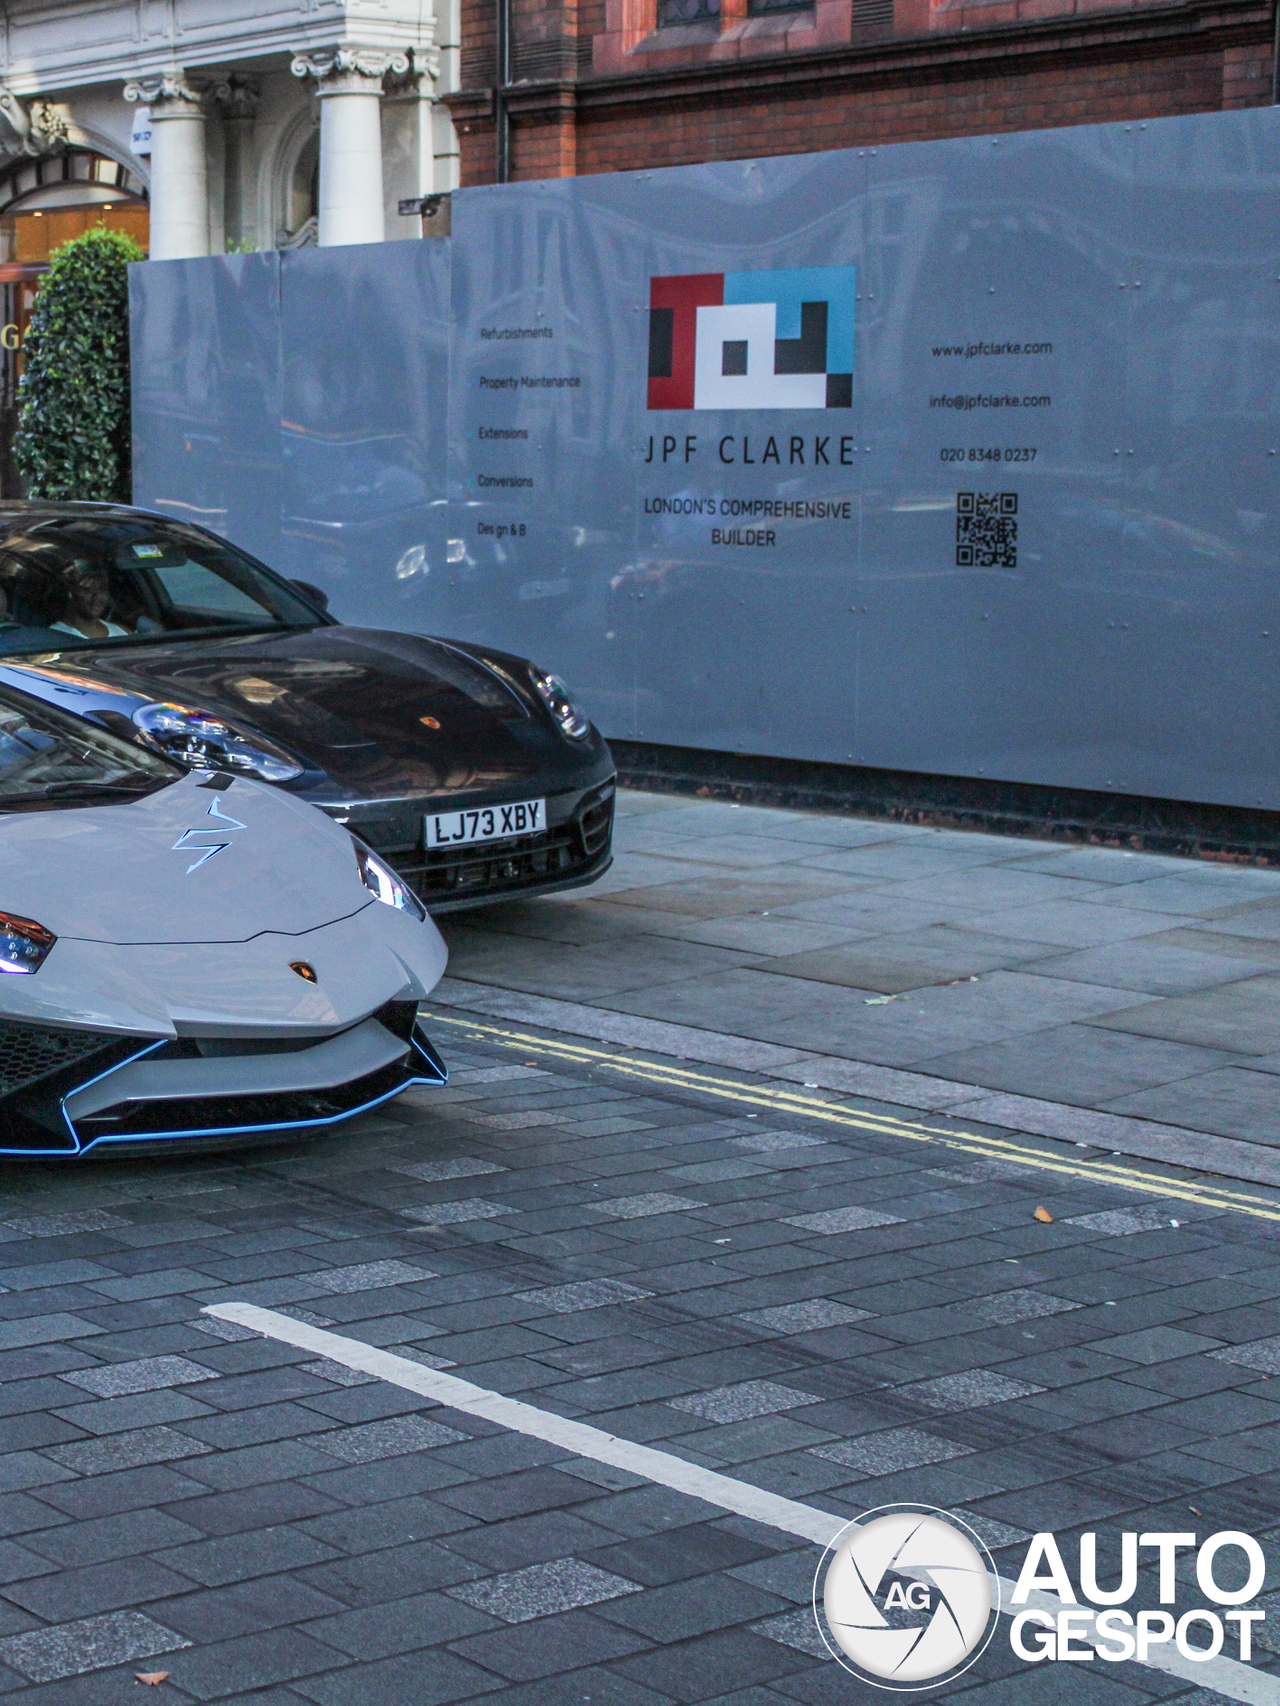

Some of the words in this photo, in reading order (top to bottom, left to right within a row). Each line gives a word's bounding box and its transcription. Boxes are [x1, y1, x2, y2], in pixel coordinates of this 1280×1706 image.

[480, 327, 554, 340] Refurbishments
[931, 342, 1053, 359] www.jpfclarke.com
[479, 376, 519, 390] Property
[521, 376, 581, 388] Maintenance
[929, 394, 1052, 411] info@jpfclarke.com
[478, 427, 529, 440] Extensions
[644, 435, 698, 464] JPF
[718, 435, 854, 466] CLARKE
[940, 448, 965, 462] 020
[968, 448, 1001, 462] 8348
[1004, 448, 1038, 462] 0237
[477, 474, 534, 488] Conversions
[644, 497, 716, 515] LONDON'S
[720, 499, 852, 519] COMPREHENSIVE
[711, 528, 776, 547] BUILDER
[435, 809, 495, 843] LJ73
[500, 802, 539, 833] XBY
